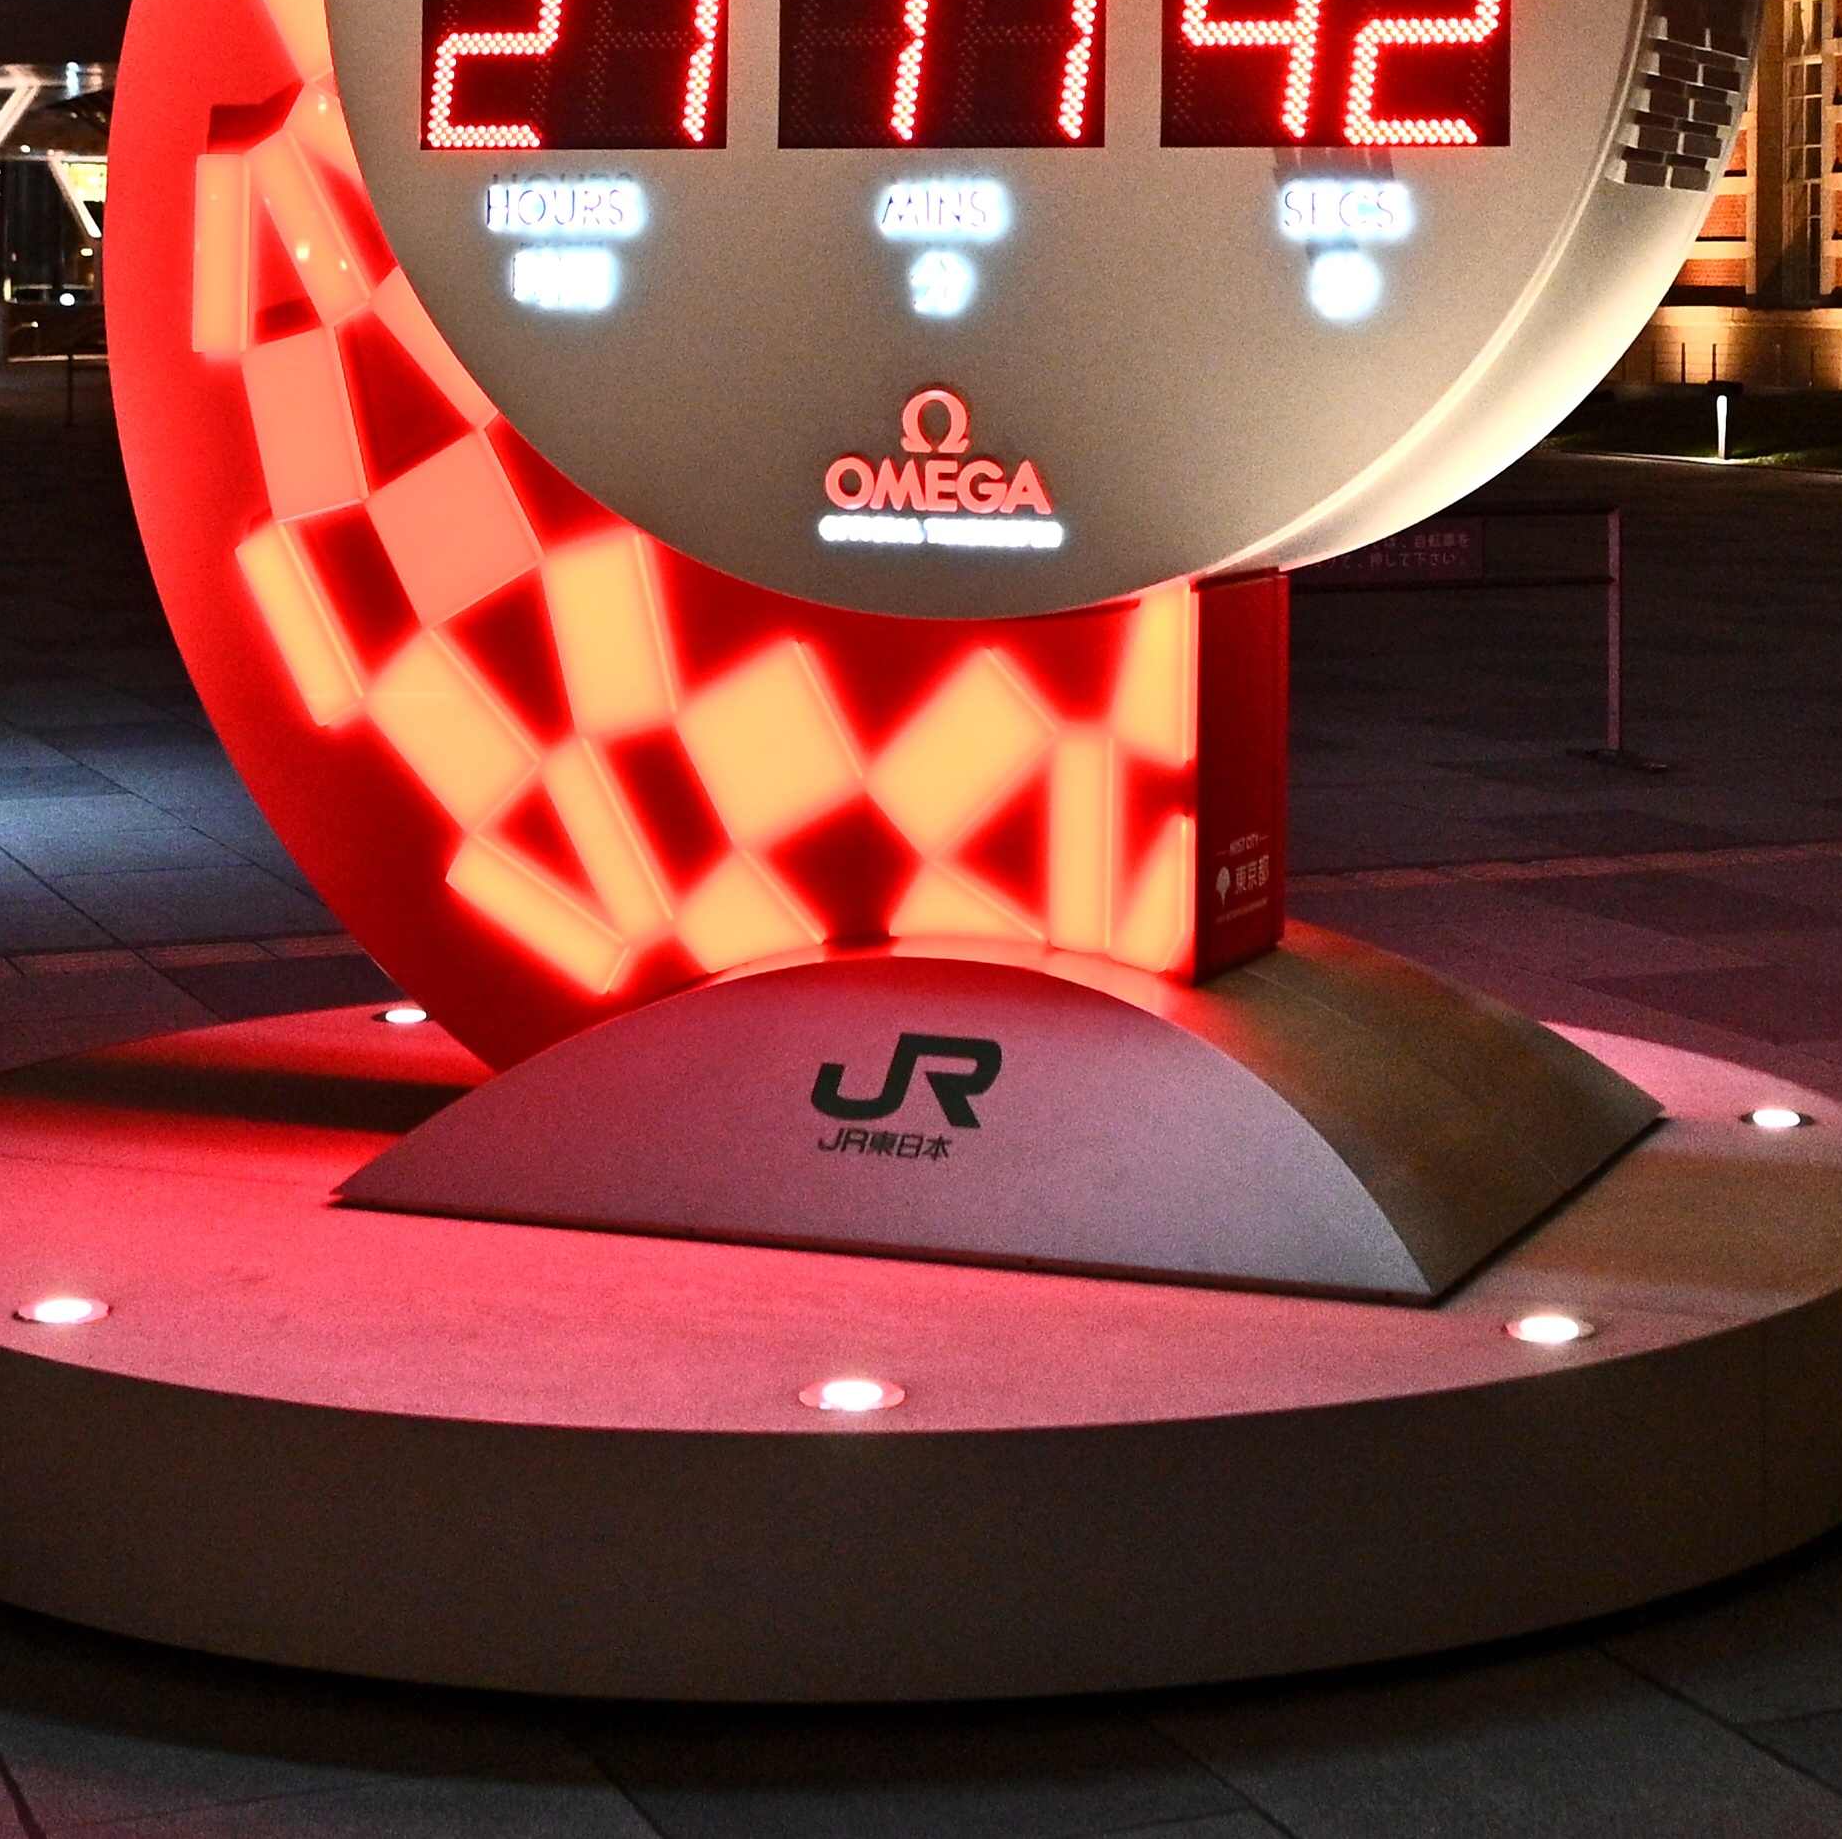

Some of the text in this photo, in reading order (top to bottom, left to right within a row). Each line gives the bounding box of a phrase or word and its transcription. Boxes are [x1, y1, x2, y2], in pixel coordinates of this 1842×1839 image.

[485, 181, 645, 238] HOURS
[876, 182, 1008, 240] MINS
[1279, 180, 1414, 241] SECS
[825, 457, 1052, 514] OMEGA
[811, 1032, 1003, 1130] JR
[818, 1128, 953, 1161] JR東日本
